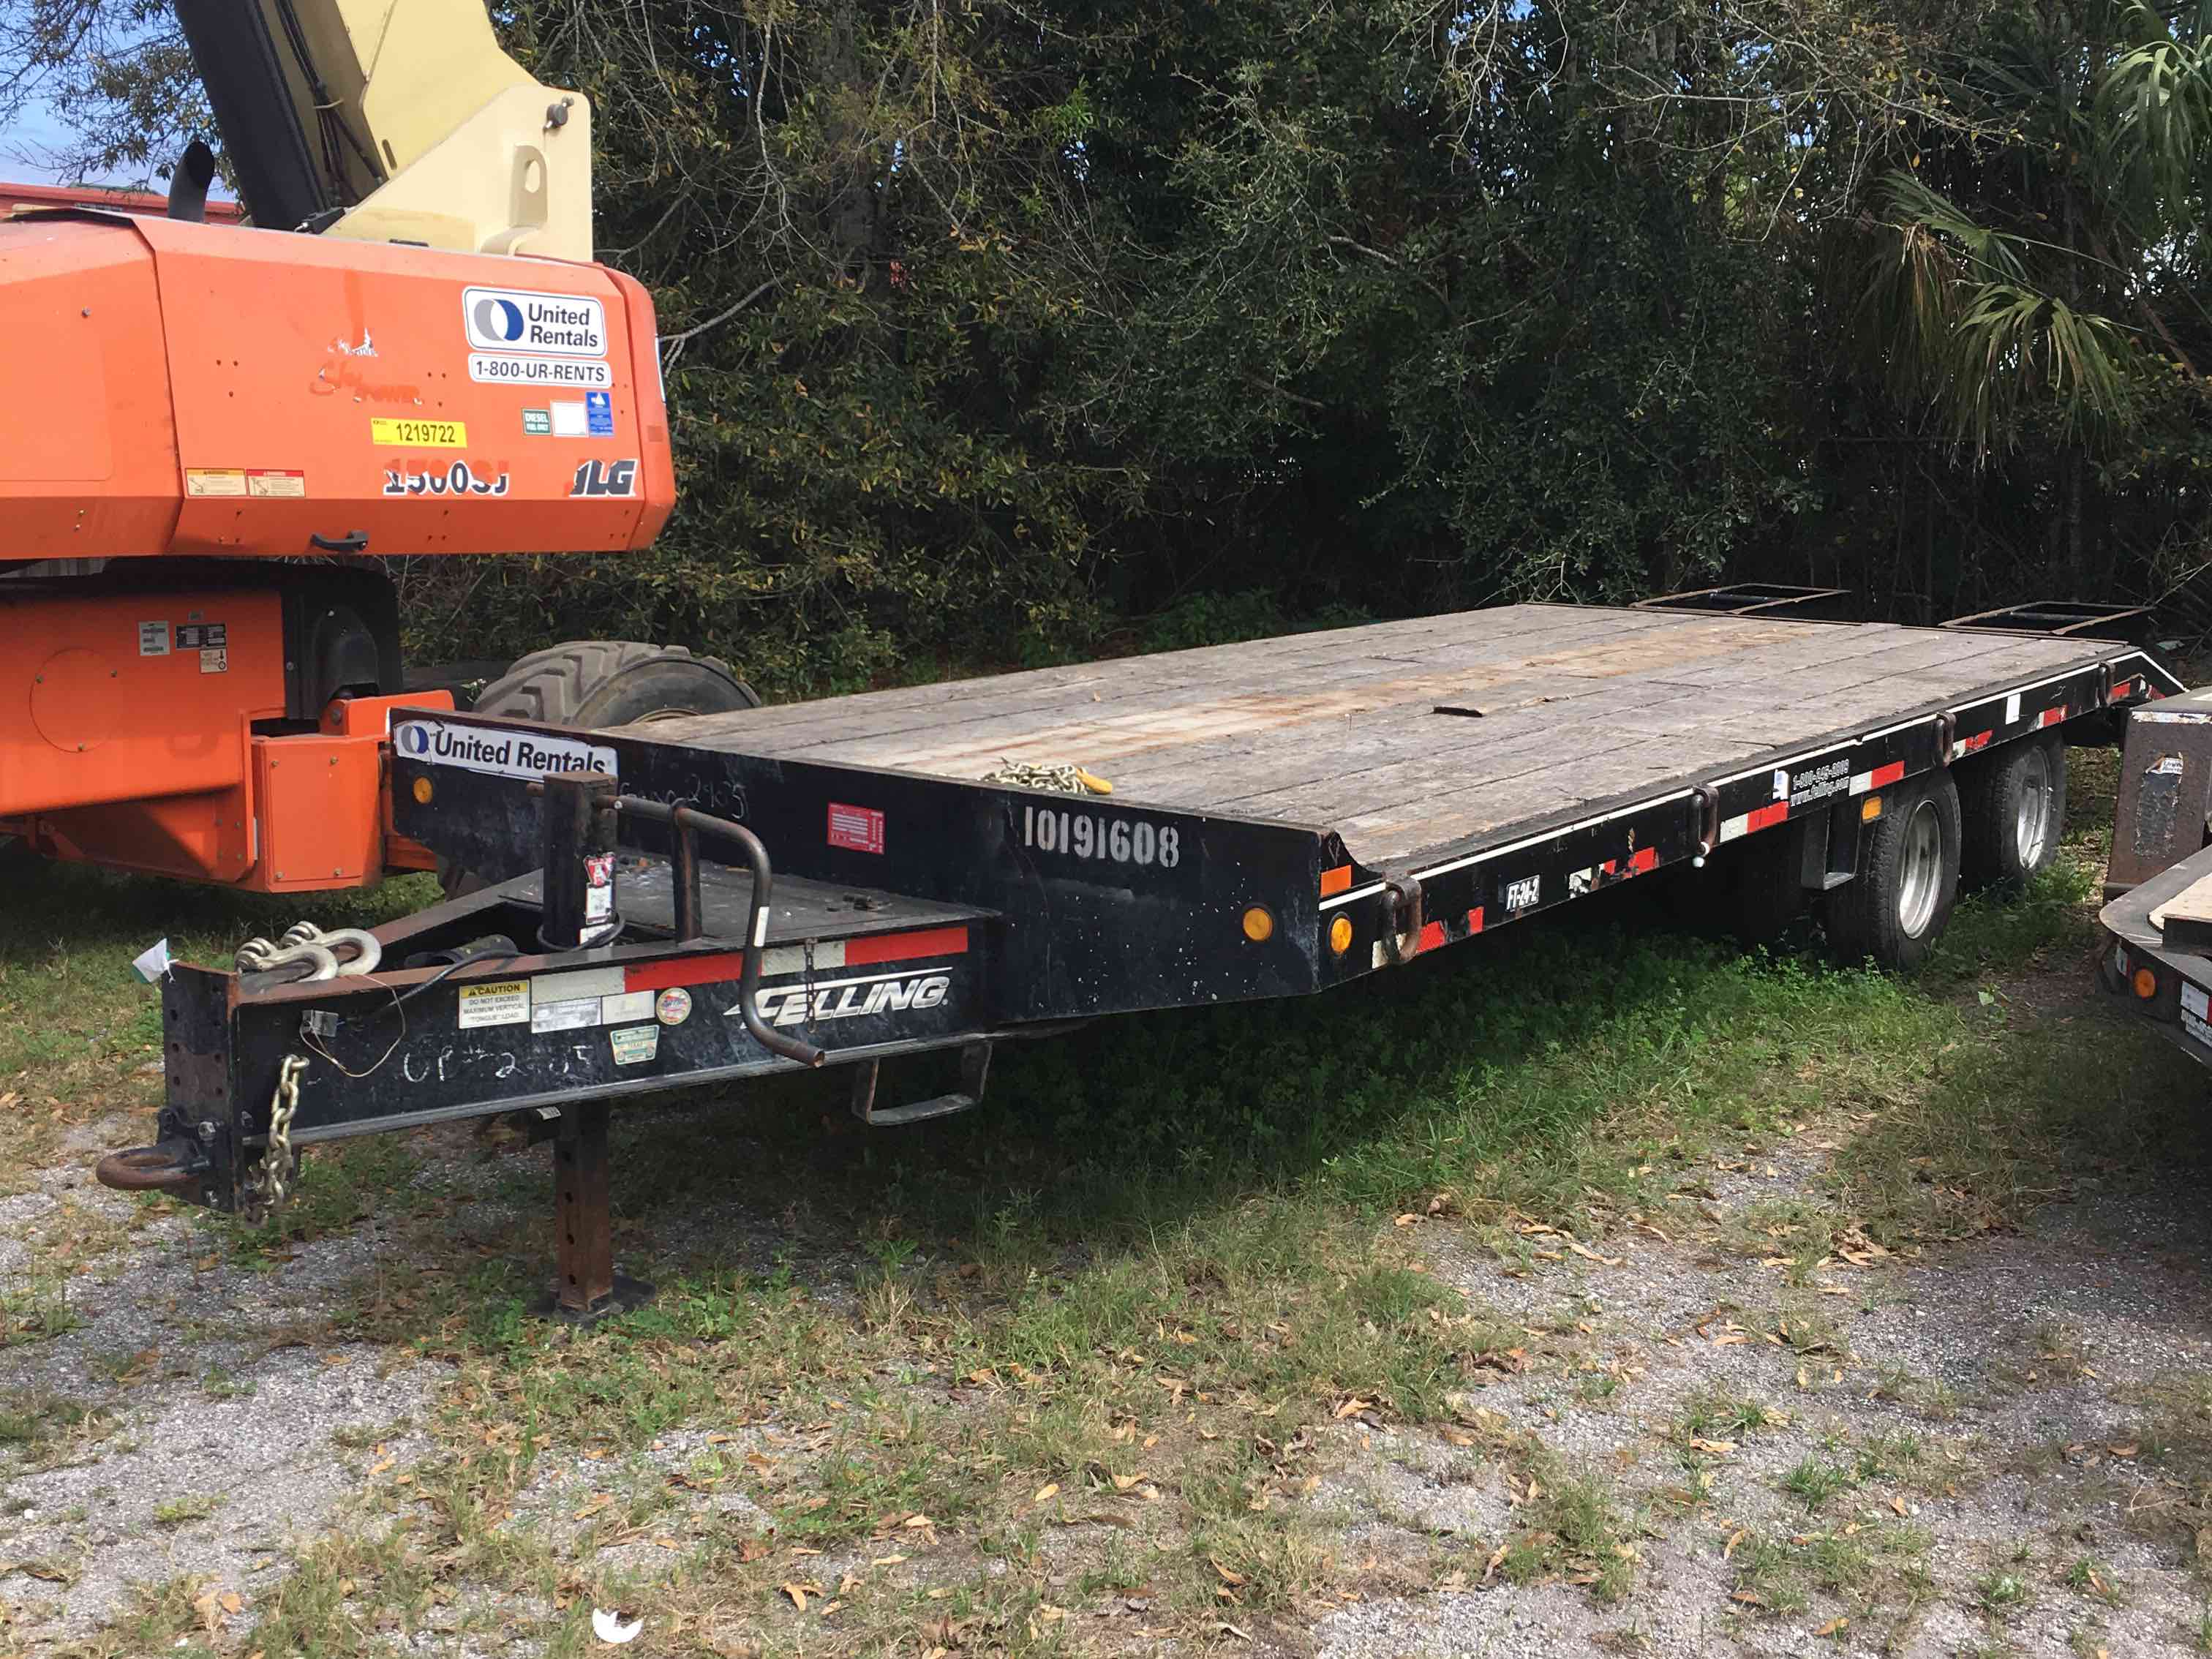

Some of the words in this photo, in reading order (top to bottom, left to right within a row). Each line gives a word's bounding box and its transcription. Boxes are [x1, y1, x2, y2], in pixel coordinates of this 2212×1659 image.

[528, 303, 590, 326] United
[530, 325, 598, 347] Rentals
[476, 361, 605, 382] 1-800-UR-RENTS
[396, 423, 456, 443] 1219722
[434, 731, 512, 765] United
[516, 741, 606, 773] Rentals
[1025, 806, 1180, 868] 10191608
[478, 984, 521, 996] CAUTION
